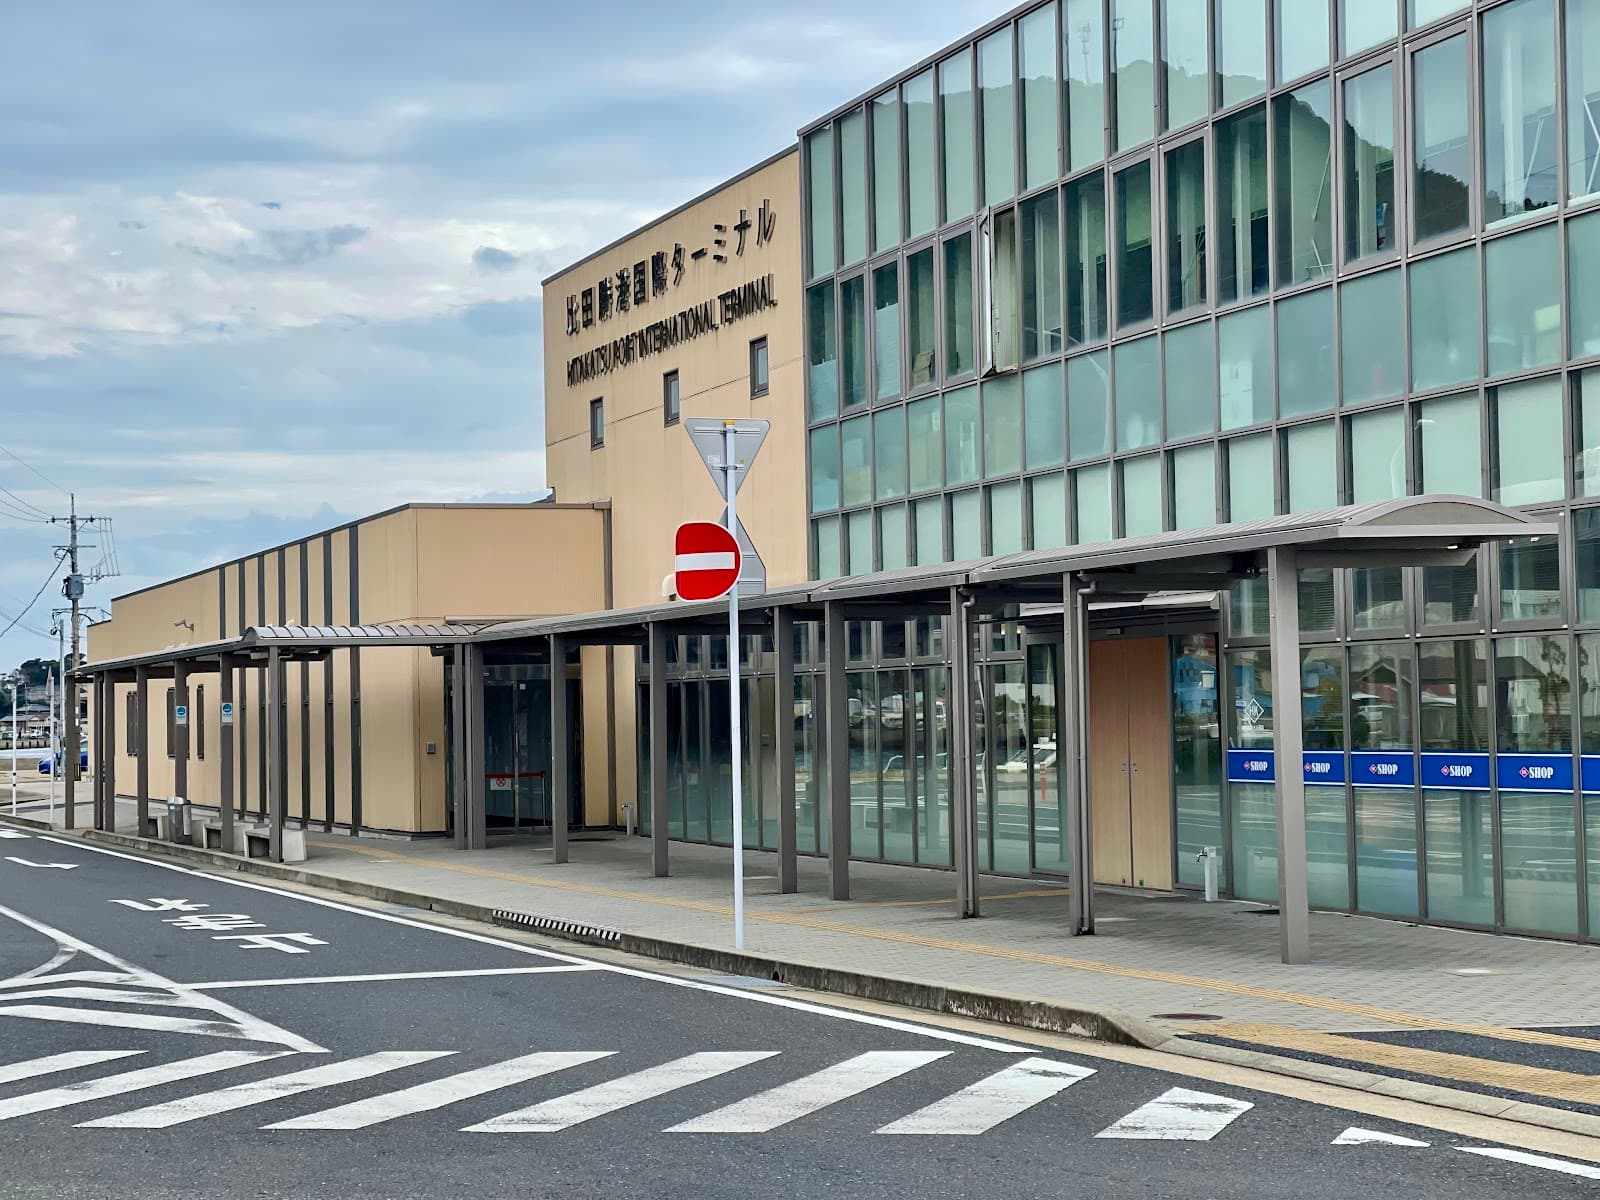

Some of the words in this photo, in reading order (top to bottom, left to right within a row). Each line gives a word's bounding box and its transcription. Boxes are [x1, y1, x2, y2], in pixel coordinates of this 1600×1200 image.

[612, 331, 639, 371] PORT
[638, 298, 720, 361] INTERNATIONAL
[717, 273, 778, 328] TERMINAL
[1250, 760, 1268, 772] SHOP
[1311, 762, 1331, 774] SHOP
[1377, 763, 1399, 775] SHOP
[1449, 765, 1473, 777] SHOP
[1528, 766, 1554, 779] SHOP
[107, 897, 330, 954] 止まれ
